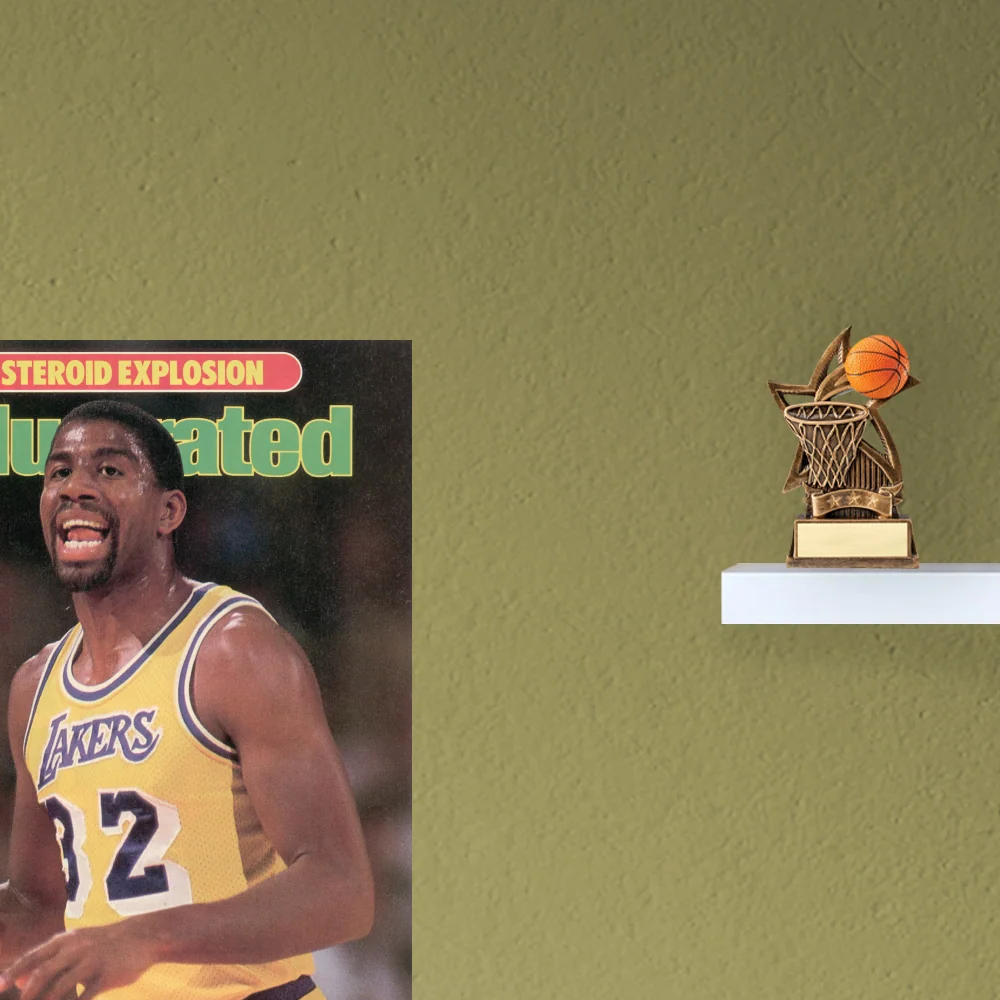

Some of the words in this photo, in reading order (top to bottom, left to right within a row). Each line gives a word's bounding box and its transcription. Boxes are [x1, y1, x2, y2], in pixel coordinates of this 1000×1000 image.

[1, 359, 113, 386] STEROID
[118, 359, 264, 386] EXPLOSION
[37, 707, 163, 793] LAKERS
